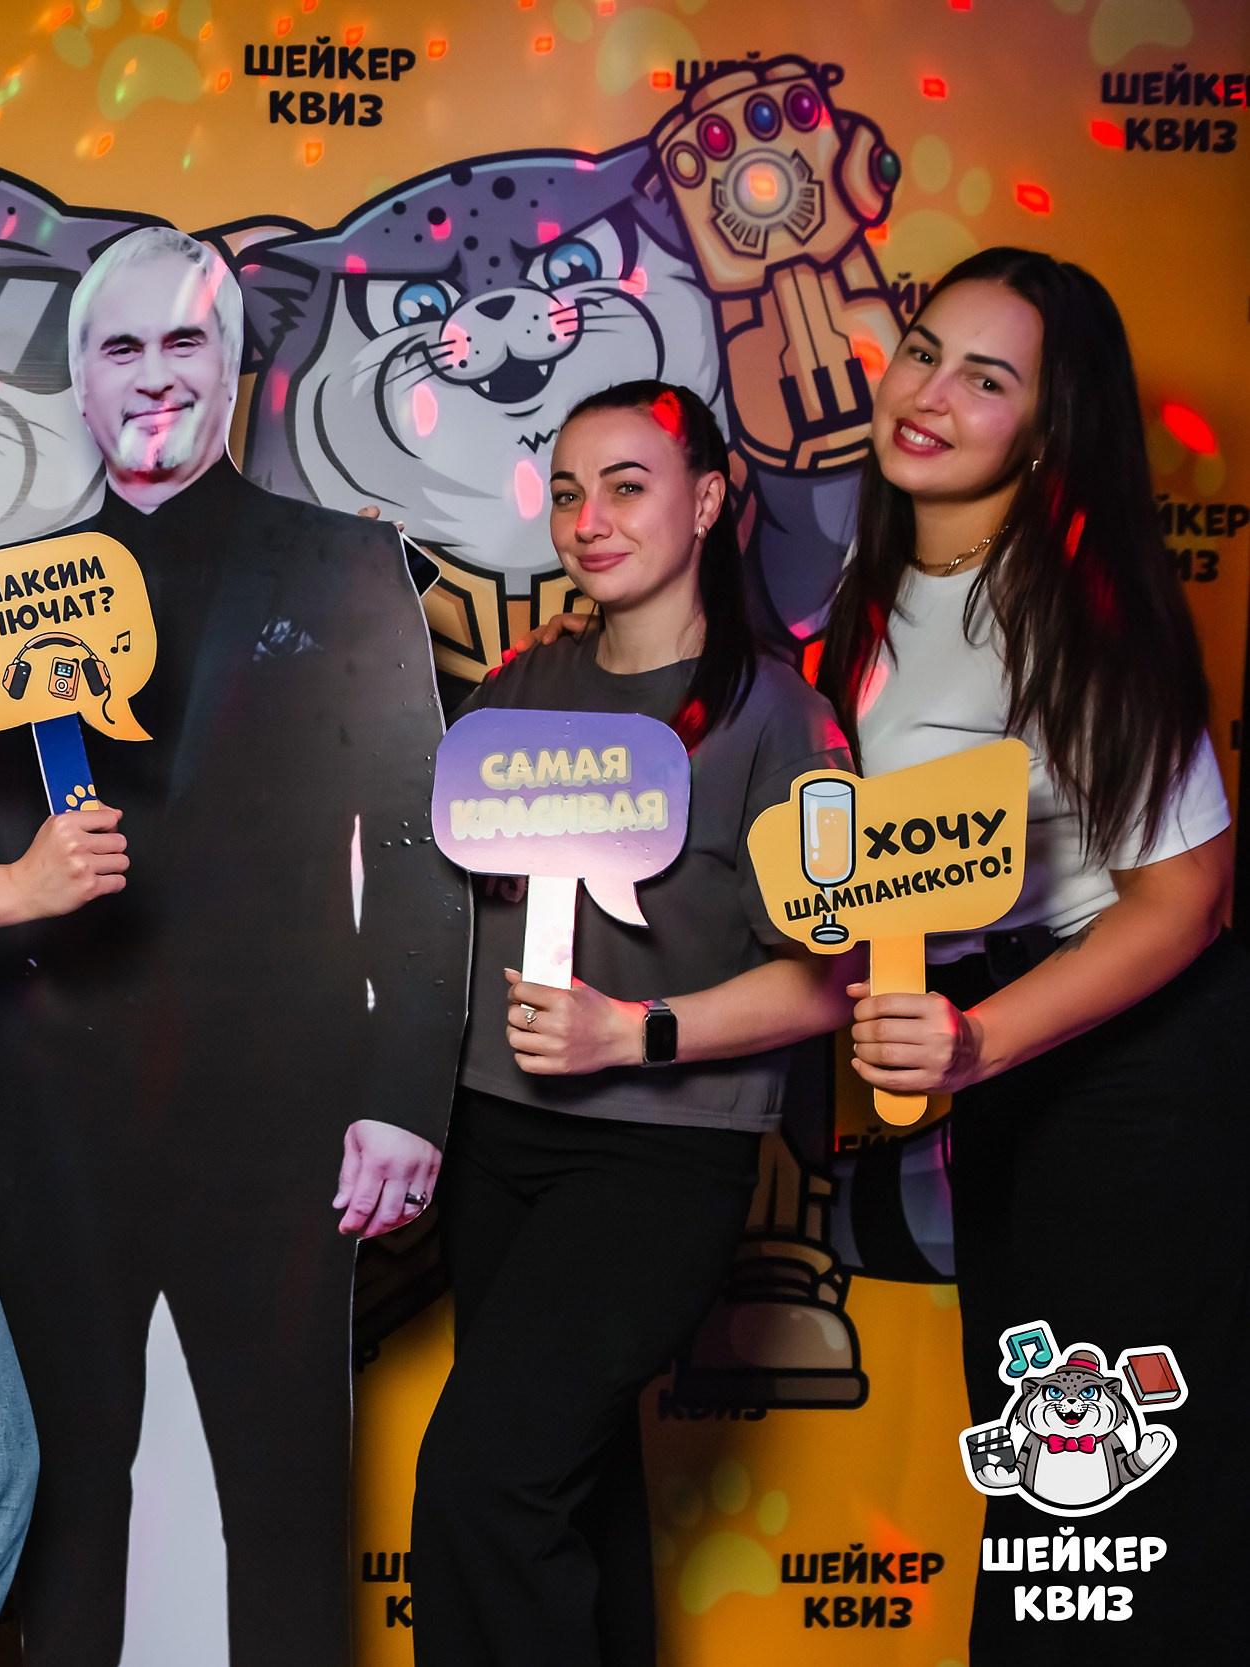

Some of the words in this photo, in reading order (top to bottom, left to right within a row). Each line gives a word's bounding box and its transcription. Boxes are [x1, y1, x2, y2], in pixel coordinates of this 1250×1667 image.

[244, 36, 416, 81] ШЕЙКЕР
[1102, 63, 1250, 107] ШЕЙКЕ
[269, 90, 383, 126] КВИЗ
[1125, 118, 1238, 153] КВИЗ
[481, 747, 630, 788] САМАЯ
[451, 791, 667, 838] КРАСИВАЯ
[863, 808, 1007, 859] ХОЧУ
[784, 847, 1012, 921] ШАМПАНСКОГО!
[781, 1543, 945, 1584] ШЕЙКЕР
[804, 1596, 913, 1628] КВИЗ
